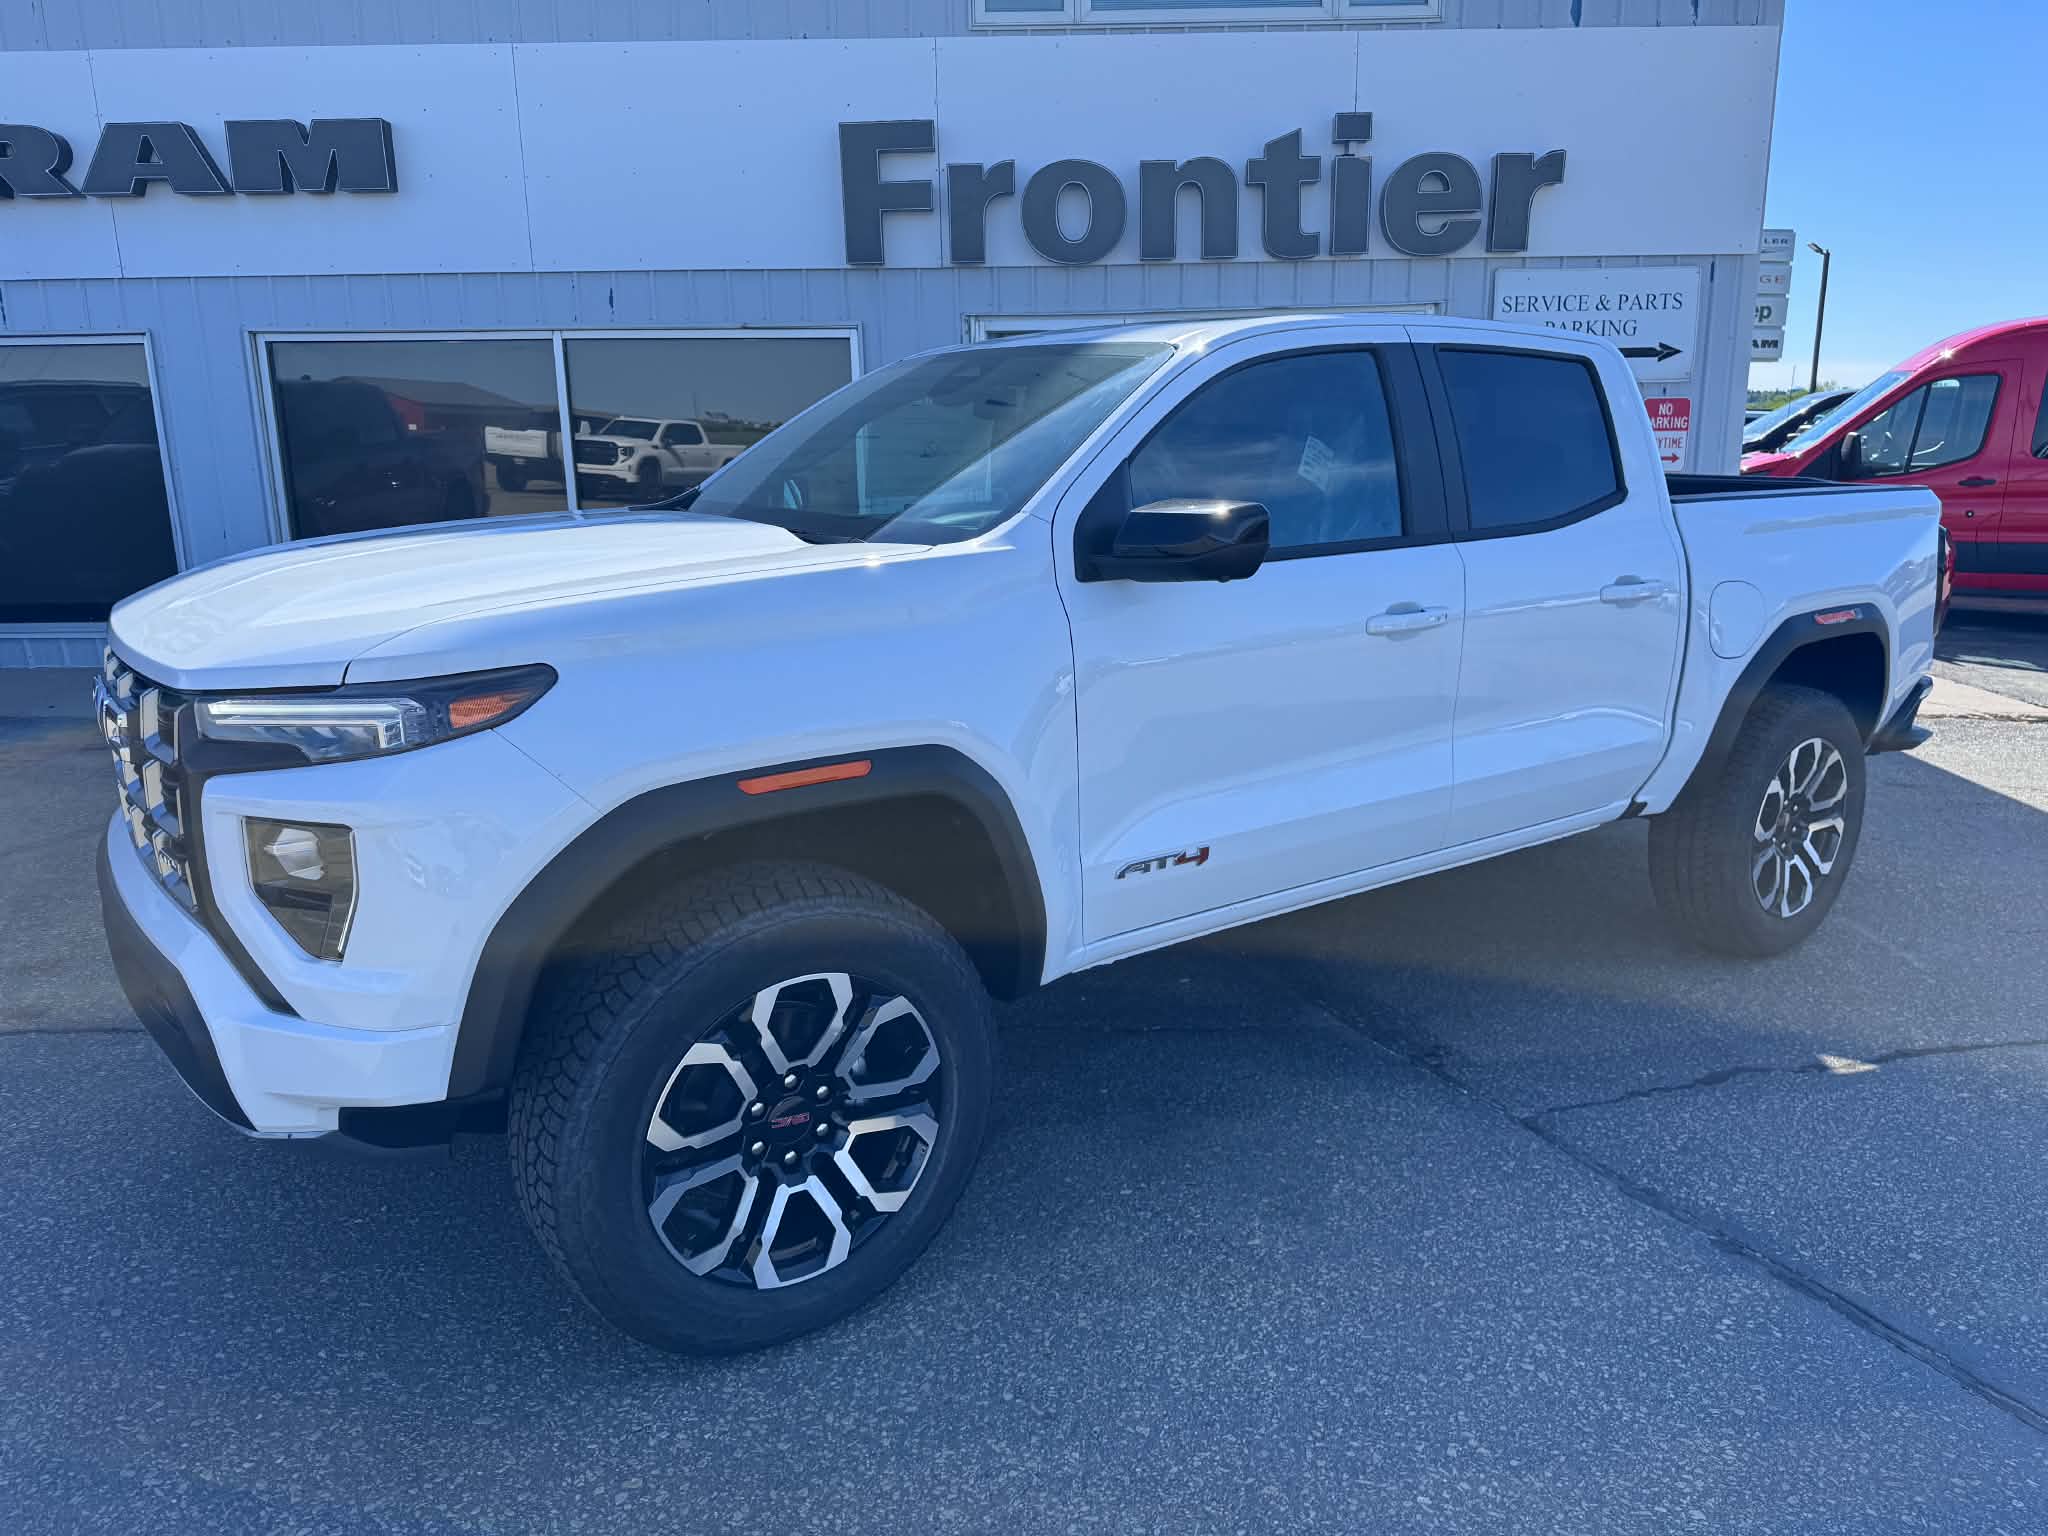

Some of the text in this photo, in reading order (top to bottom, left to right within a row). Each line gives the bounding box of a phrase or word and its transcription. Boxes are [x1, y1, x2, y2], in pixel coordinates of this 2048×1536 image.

[0, 118, 398, 199] RAM
[839, 112, 1567, 267] Frontier
[1502, 292, 1683, 313] SERVICE & PARTS
[1658, 403, 1673, 416] NO
[1651, 416, 1688, 429] ARKING
[1656, 436, 1684, 449] YTIME
[1115, 846, 1209, 879] AT4
